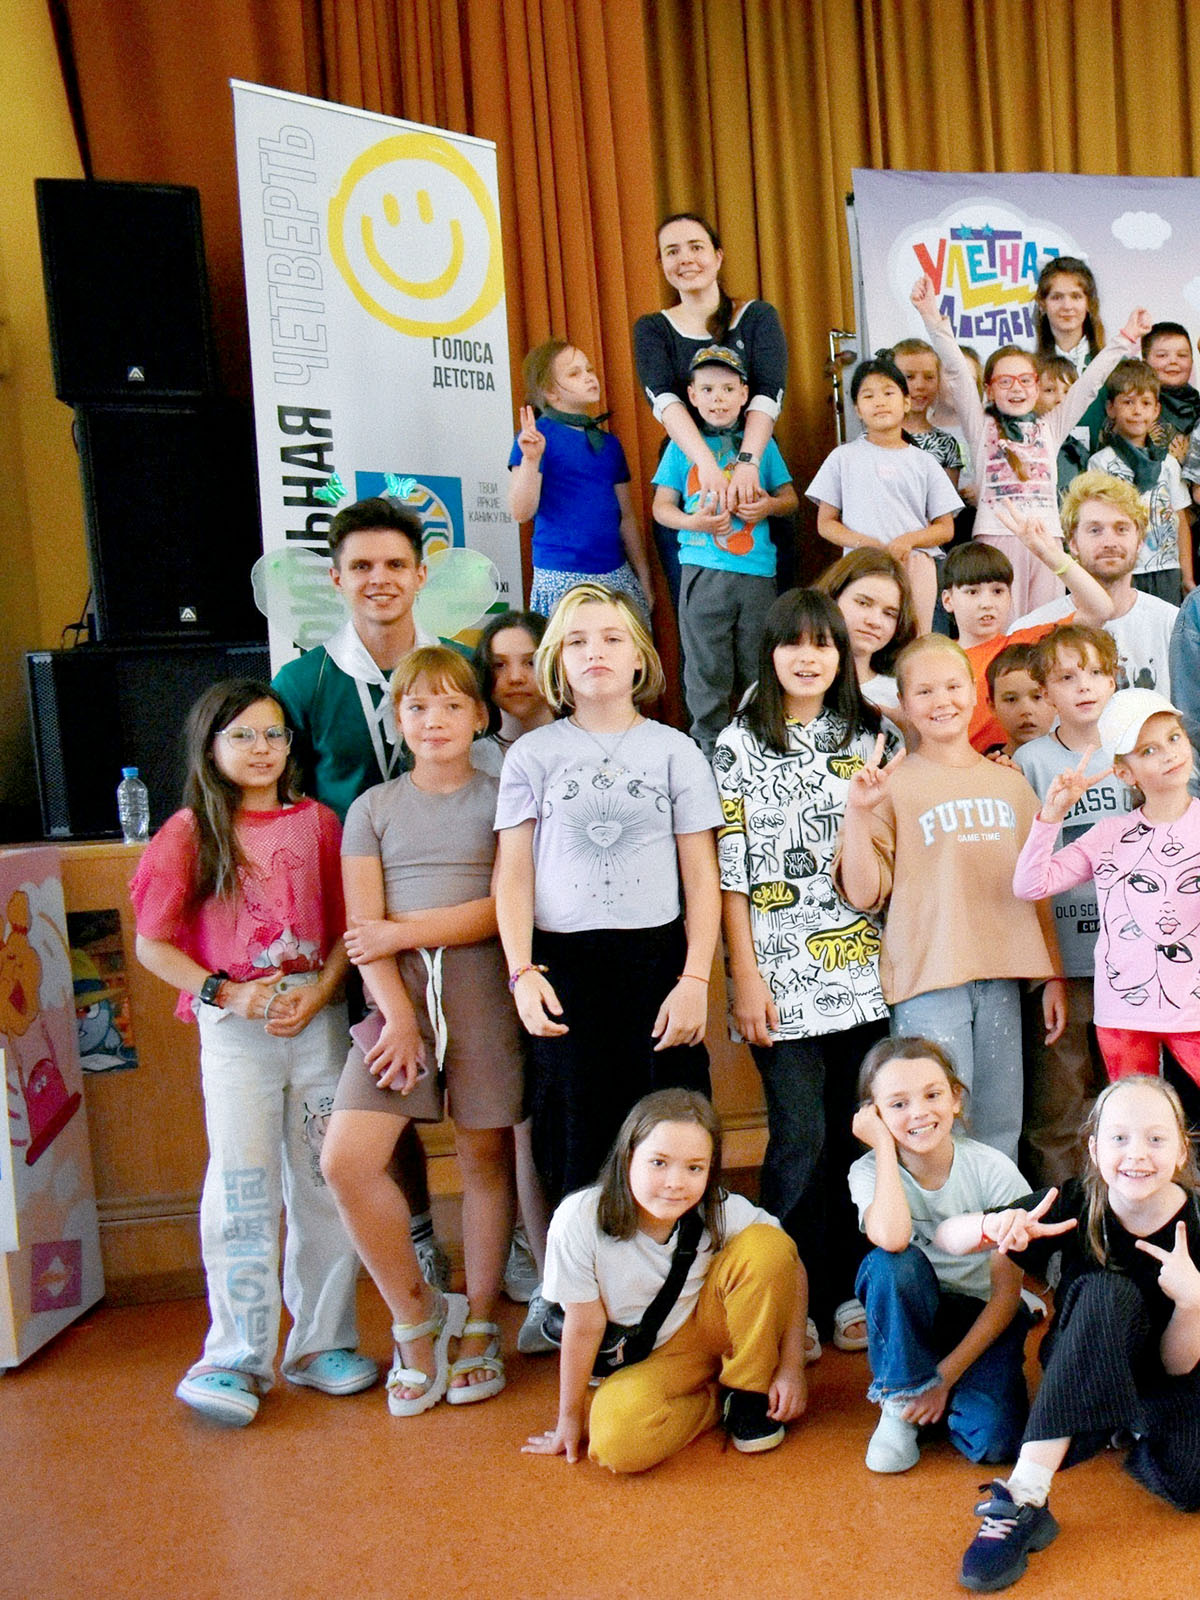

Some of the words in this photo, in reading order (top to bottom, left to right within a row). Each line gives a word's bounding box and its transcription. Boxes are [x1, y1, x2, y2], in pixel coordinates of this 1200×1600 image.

[258, 125, 329, 386] ЧЕТВЕРТЬ
[432, 335, 494, 365] ГОЛОСА
[432, 366, 496, 392] ДЕТСТВА
[982, 832, 1001, 841] TIME
[1055, 904, 1077, 919] OLD
